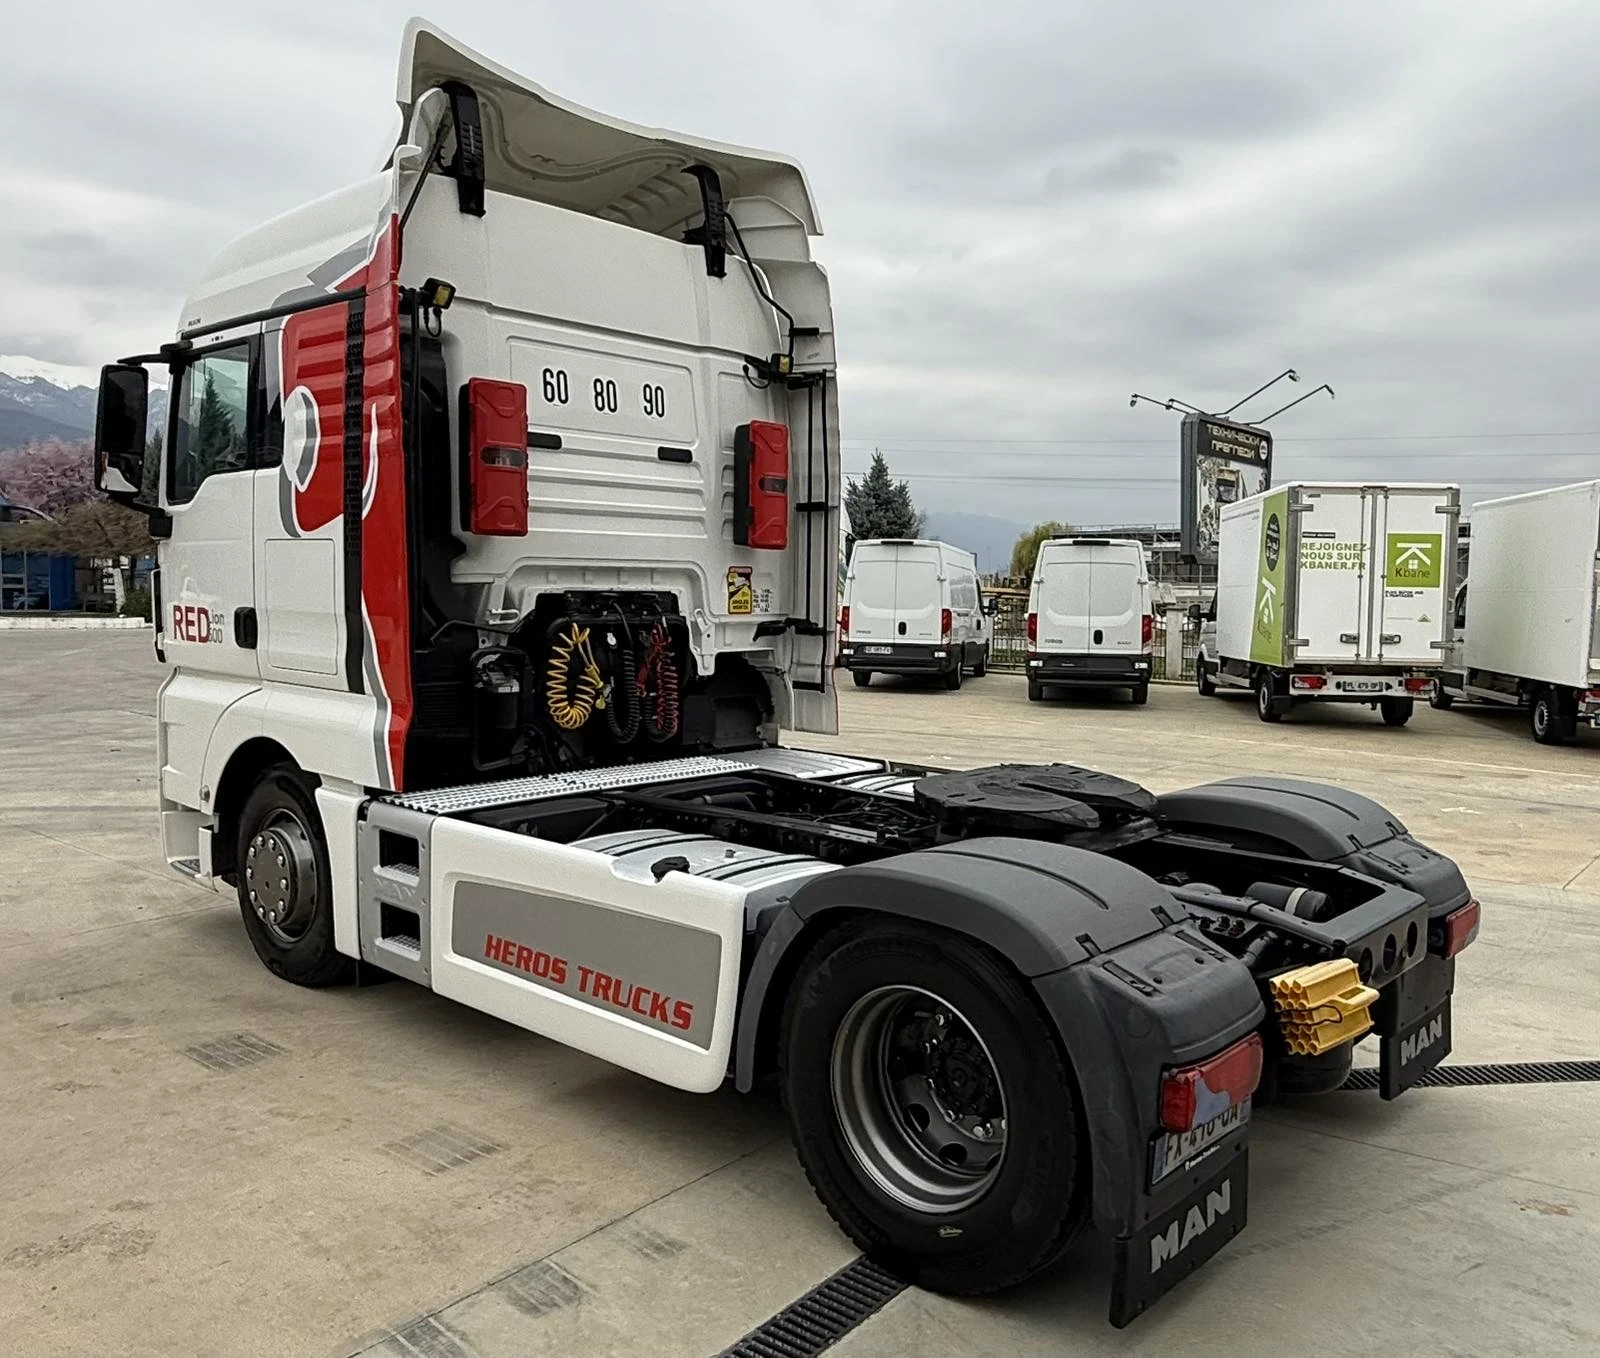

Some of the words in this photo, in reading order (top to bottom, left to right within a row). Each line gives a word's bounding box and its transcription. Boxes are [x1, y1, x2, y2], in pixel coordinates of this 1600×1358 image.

[542, 367, 569, 404] 60
[593, 378, 617, 413] 80
[643, 383, 665, 418] 90
[1300, 561, 1366, 570] KBANER.FR
[1301, 552, 1333, 560] NOUS
[1337, 552, 1360, 560] SUR
[1395, 567, 1431, 578] Kbane
[173, 605, 210, 643] RED
[484, 934, 568, 985] HEROS
[577, 965, 694, 1031] TRUCKS
[1400, 1013, 1442, 1067] MAN
[1151, 1179, 1231, 1274] MAN
